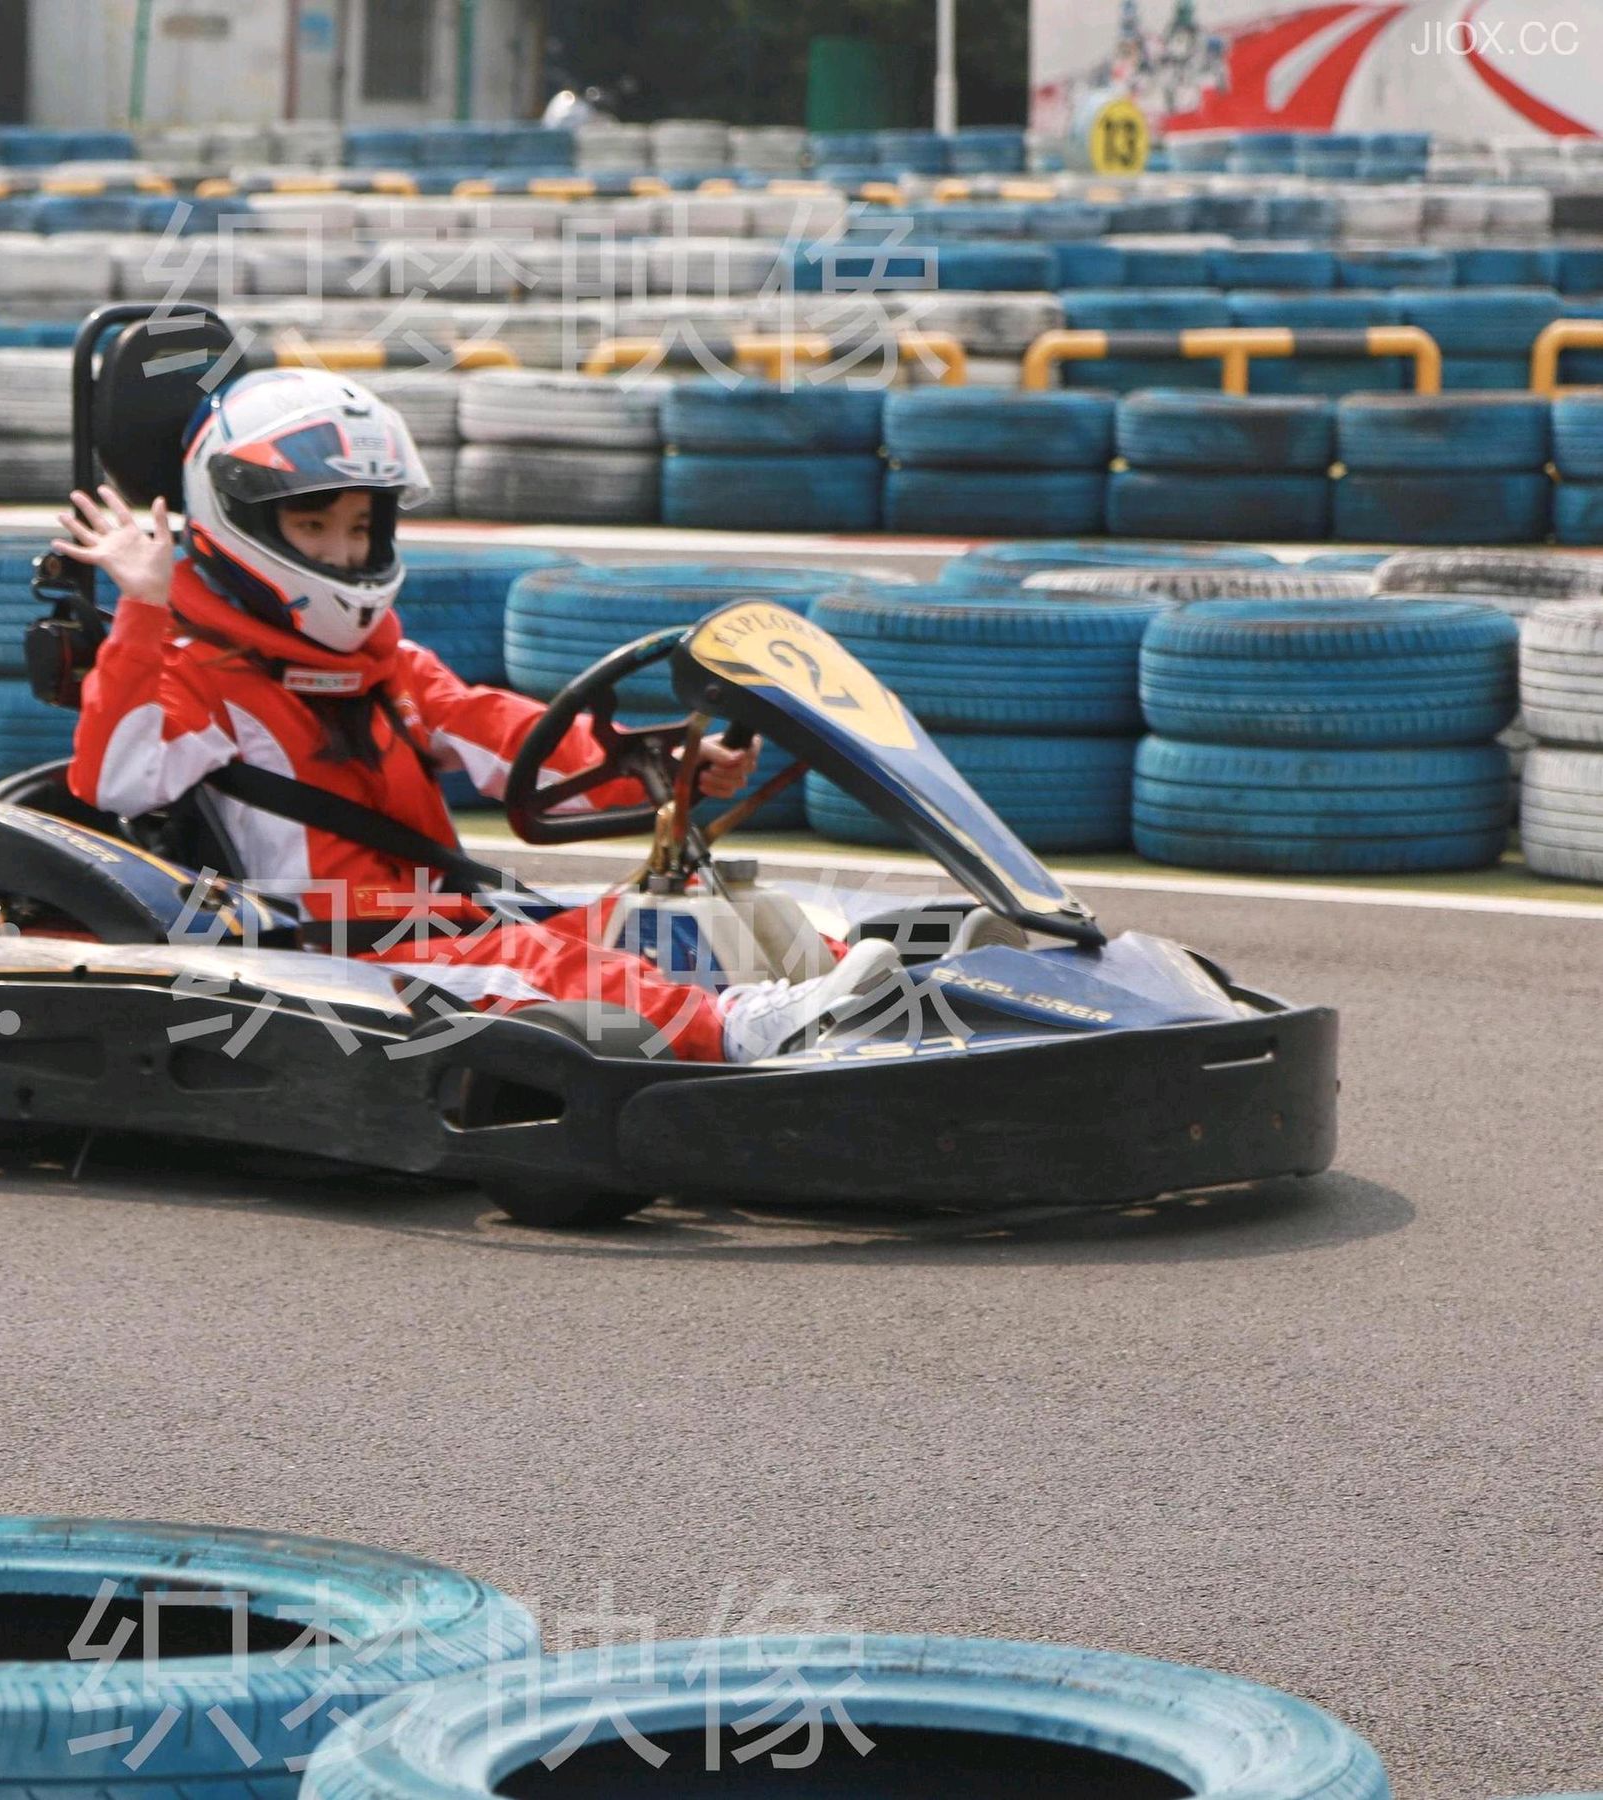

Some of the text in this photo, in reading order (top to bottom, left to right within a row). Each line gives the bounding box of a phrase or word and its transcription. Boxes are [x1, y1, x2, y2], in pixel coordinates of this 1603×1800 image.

[1104, 118, 1137, 167] 13
[713, 612, 840, 652] EXPLOR
[768, 640, 863, 710] 2
[930, 967, 1113, 1024] EXPLORER
